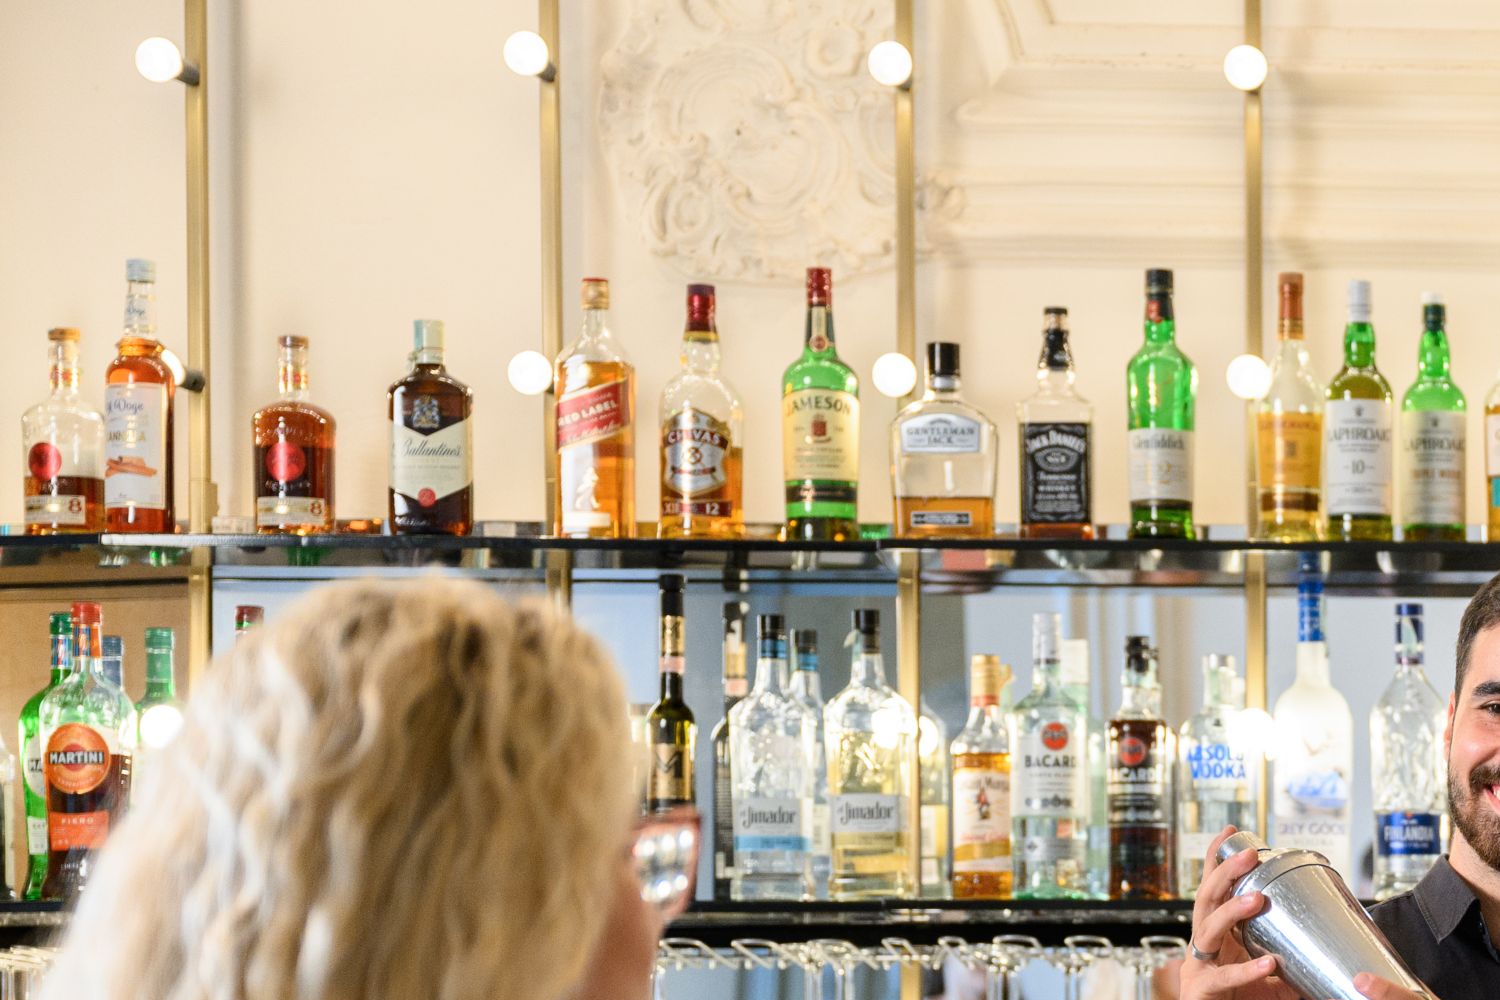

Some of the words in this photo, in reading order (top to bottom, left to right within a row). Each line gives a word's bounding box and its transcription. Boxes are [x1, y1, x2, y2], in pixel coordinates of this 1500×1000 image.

[668, 429, 720, 444] CHVAS
[1352, 459, 1365, 474] 10
[69, 498, 81, 513] 8
[310, 502, 322, 515] 8
[705, 503, 719, 515] 12
[50, 752, 104, 764] MARTINI
[1191, 763, 1246, 779] VODKA
[61, 817, 95, 825] FIERO
